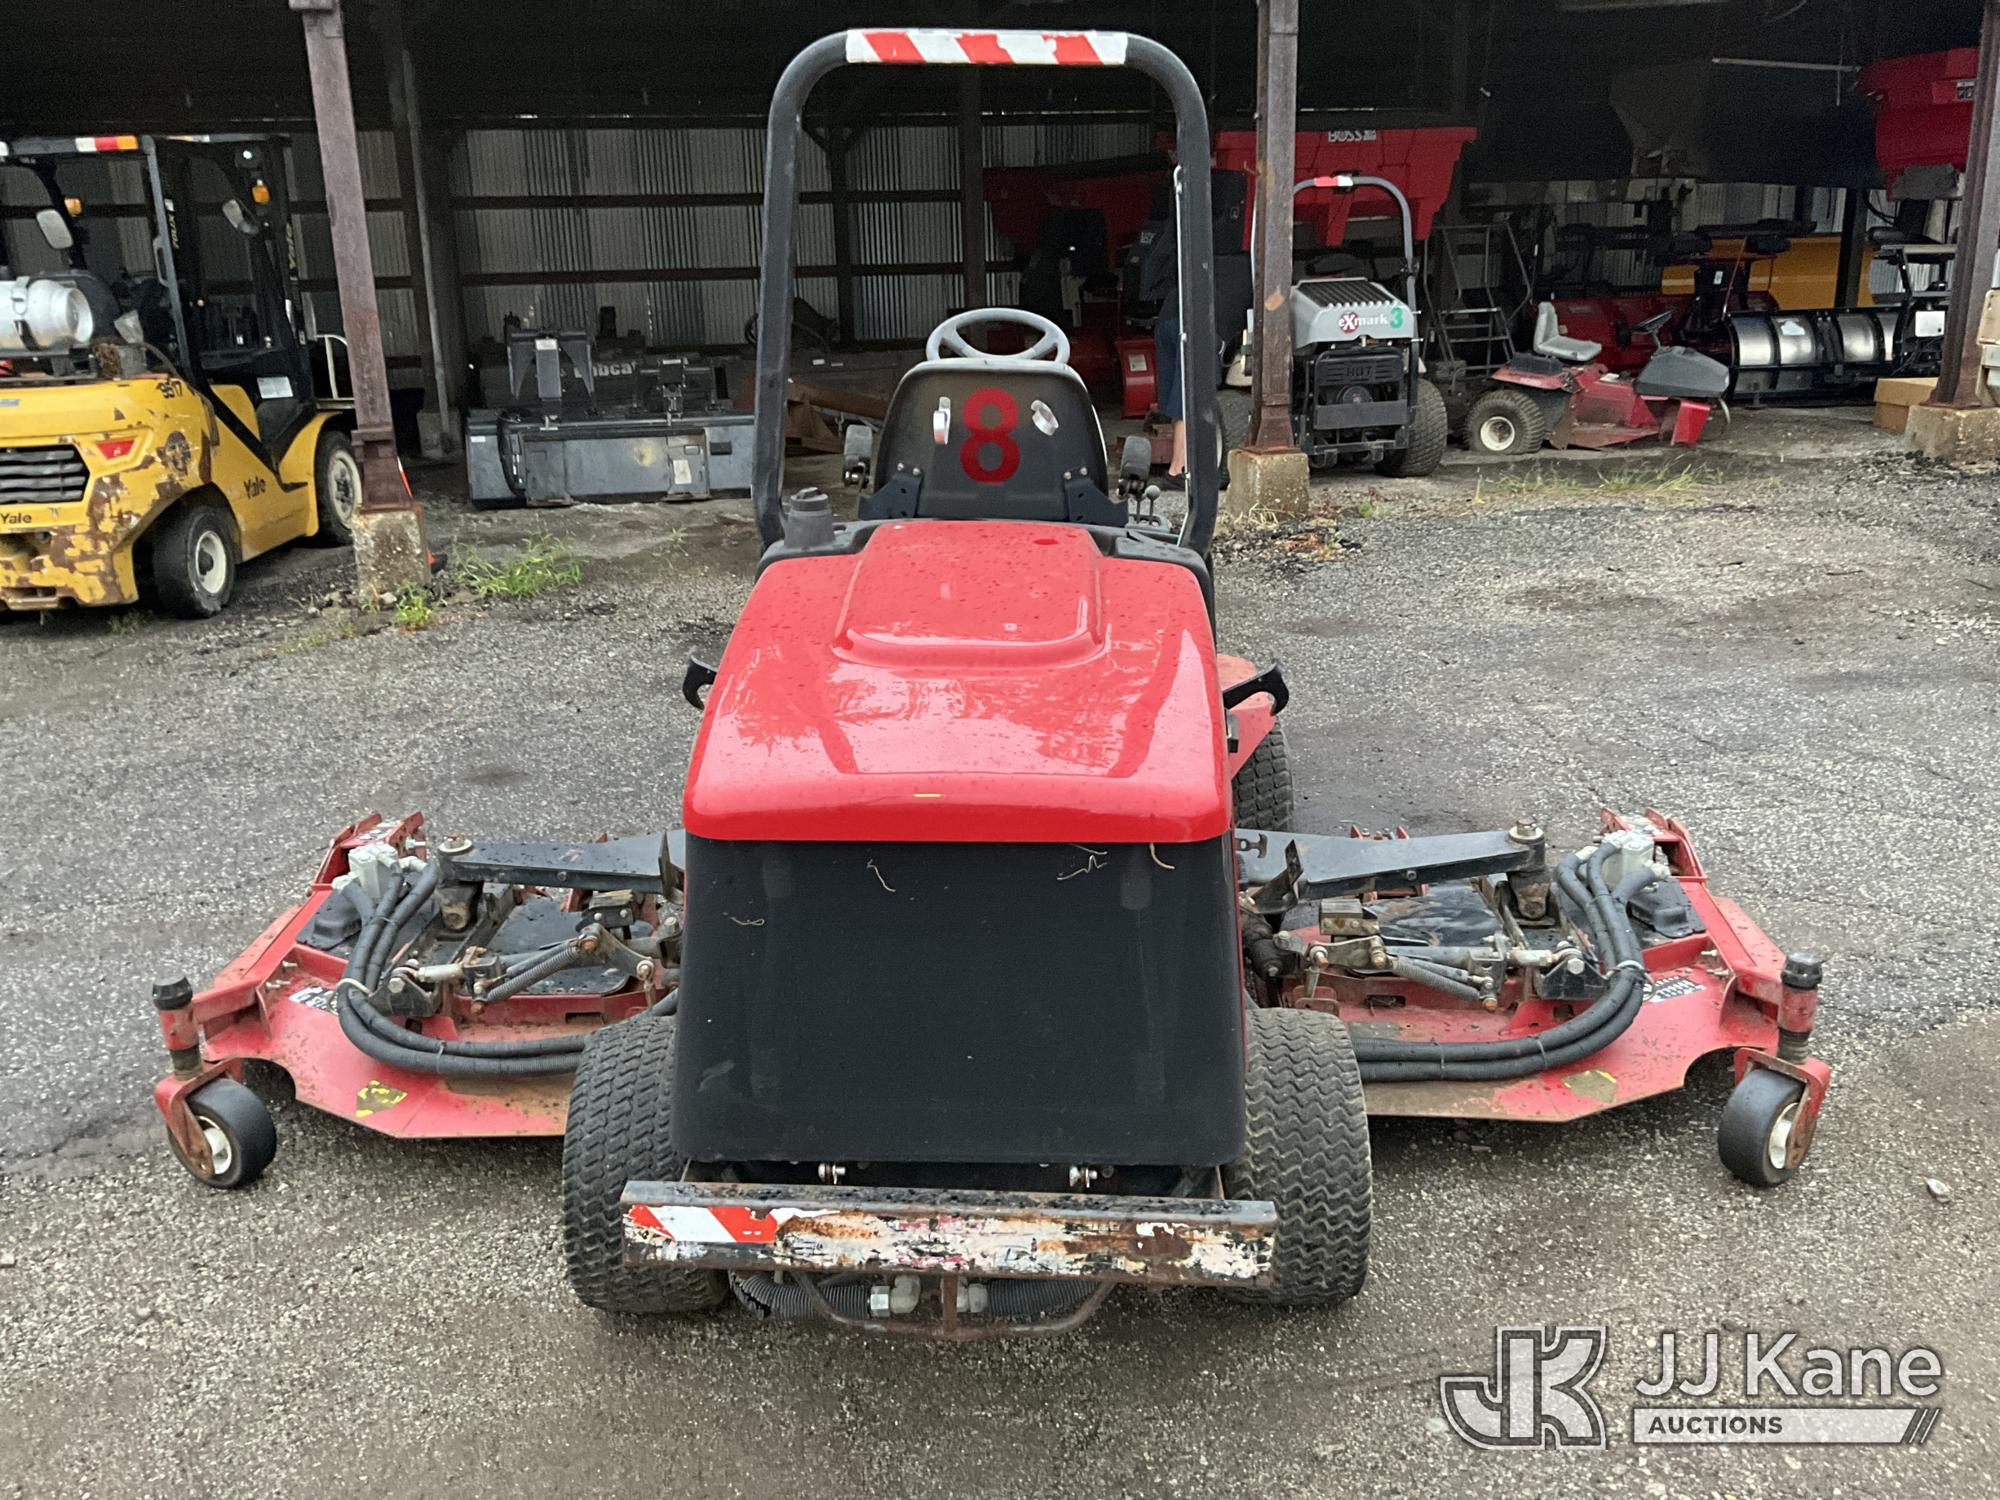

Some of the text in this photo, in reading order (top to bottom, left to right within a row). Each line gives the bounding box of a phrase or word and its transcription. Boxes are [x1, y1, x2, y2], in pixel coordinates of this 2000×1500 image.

[286, 222, 297, 269] Yale
[1390, 307, 1403, 329] 3
[960, 386, 1021, 485] 8
[243, 476, 266, 500] Yale
[0, 512, 32, 524] Yale
